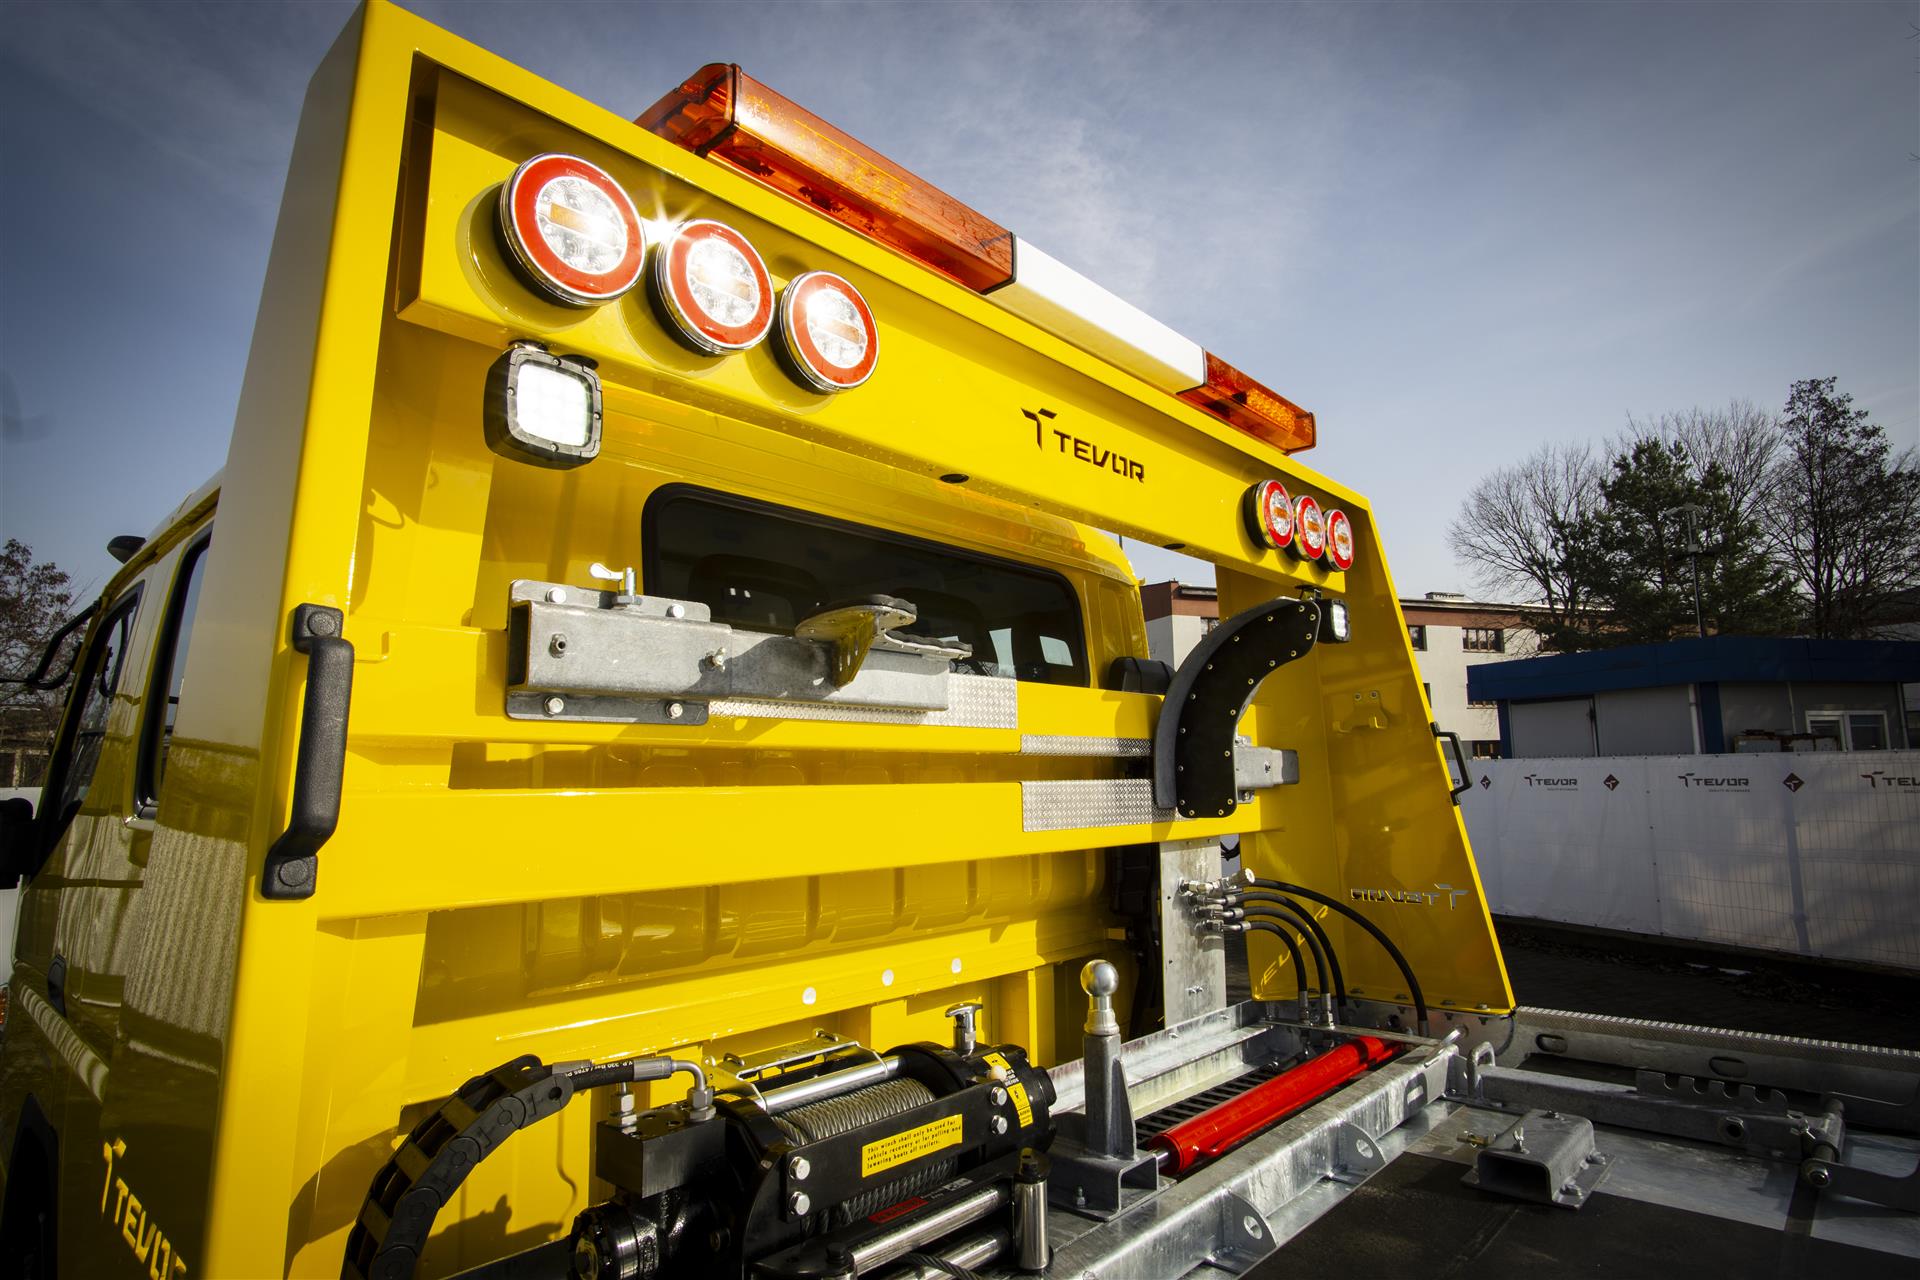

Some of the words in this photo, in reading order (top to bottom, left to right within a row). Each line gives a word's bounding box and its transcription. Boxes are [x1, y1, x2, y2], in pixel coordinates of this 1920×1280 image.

[1053, 428, 1145, 484] TEVOR
[1535, 778, 1578, 786] TEVOR
[1692, 777, 1749, 787] TEVOR
[867, 1151, 888, 1161] vehicle
[889, 1142, 913, 1153] recovery
[922, 1134, 931, 1142] for
[931, 1129, 949, 1140] pulling
[880, 1139, 897, 1149] winch
[898, 1133, 912, 1143] shall
[913, 1130, 925, 1138] only
[934, 1123, 946, 1131] used
[867, 1157, 892, 1169] lowering
[893, 1150, 908, 1160] boats
